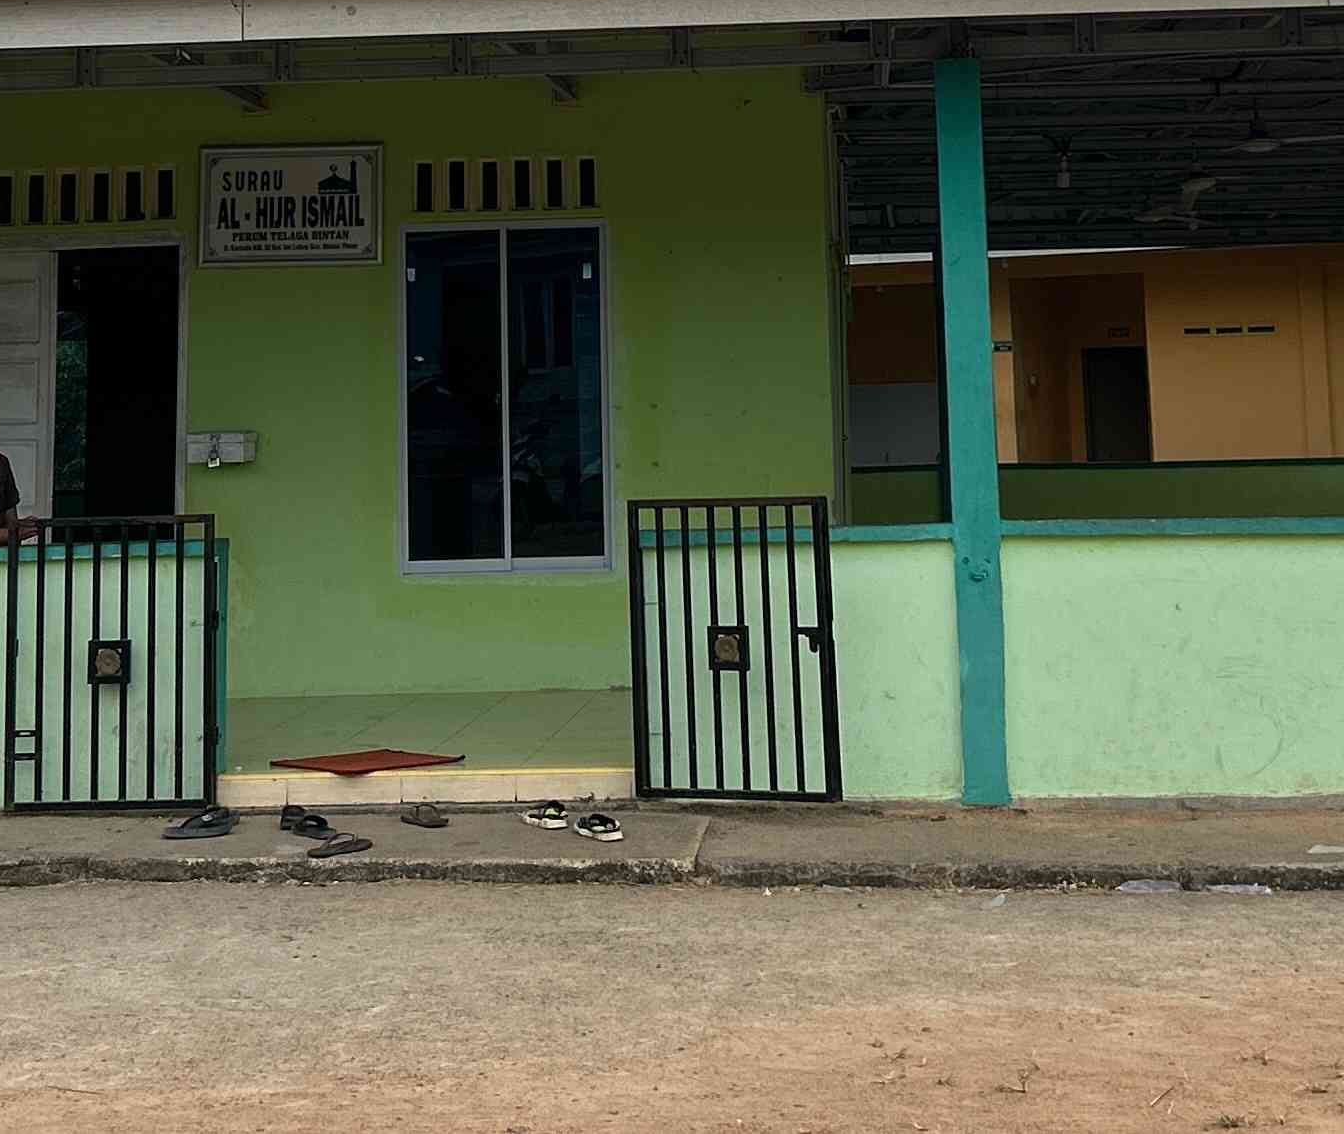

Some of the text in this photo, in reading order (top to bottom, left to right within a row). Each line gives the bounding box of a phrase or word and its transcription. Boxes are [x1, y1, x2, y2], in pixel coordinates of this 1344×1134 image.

[222, 170, 283, 191] SURAU
[217, 197, 240, 229] AL
[256, 196, 296, 228] HIJR
[302, 195, 364, 228] ISMAIL
[232, 230, 350, 242] PERUM TELAGA BINTAN
